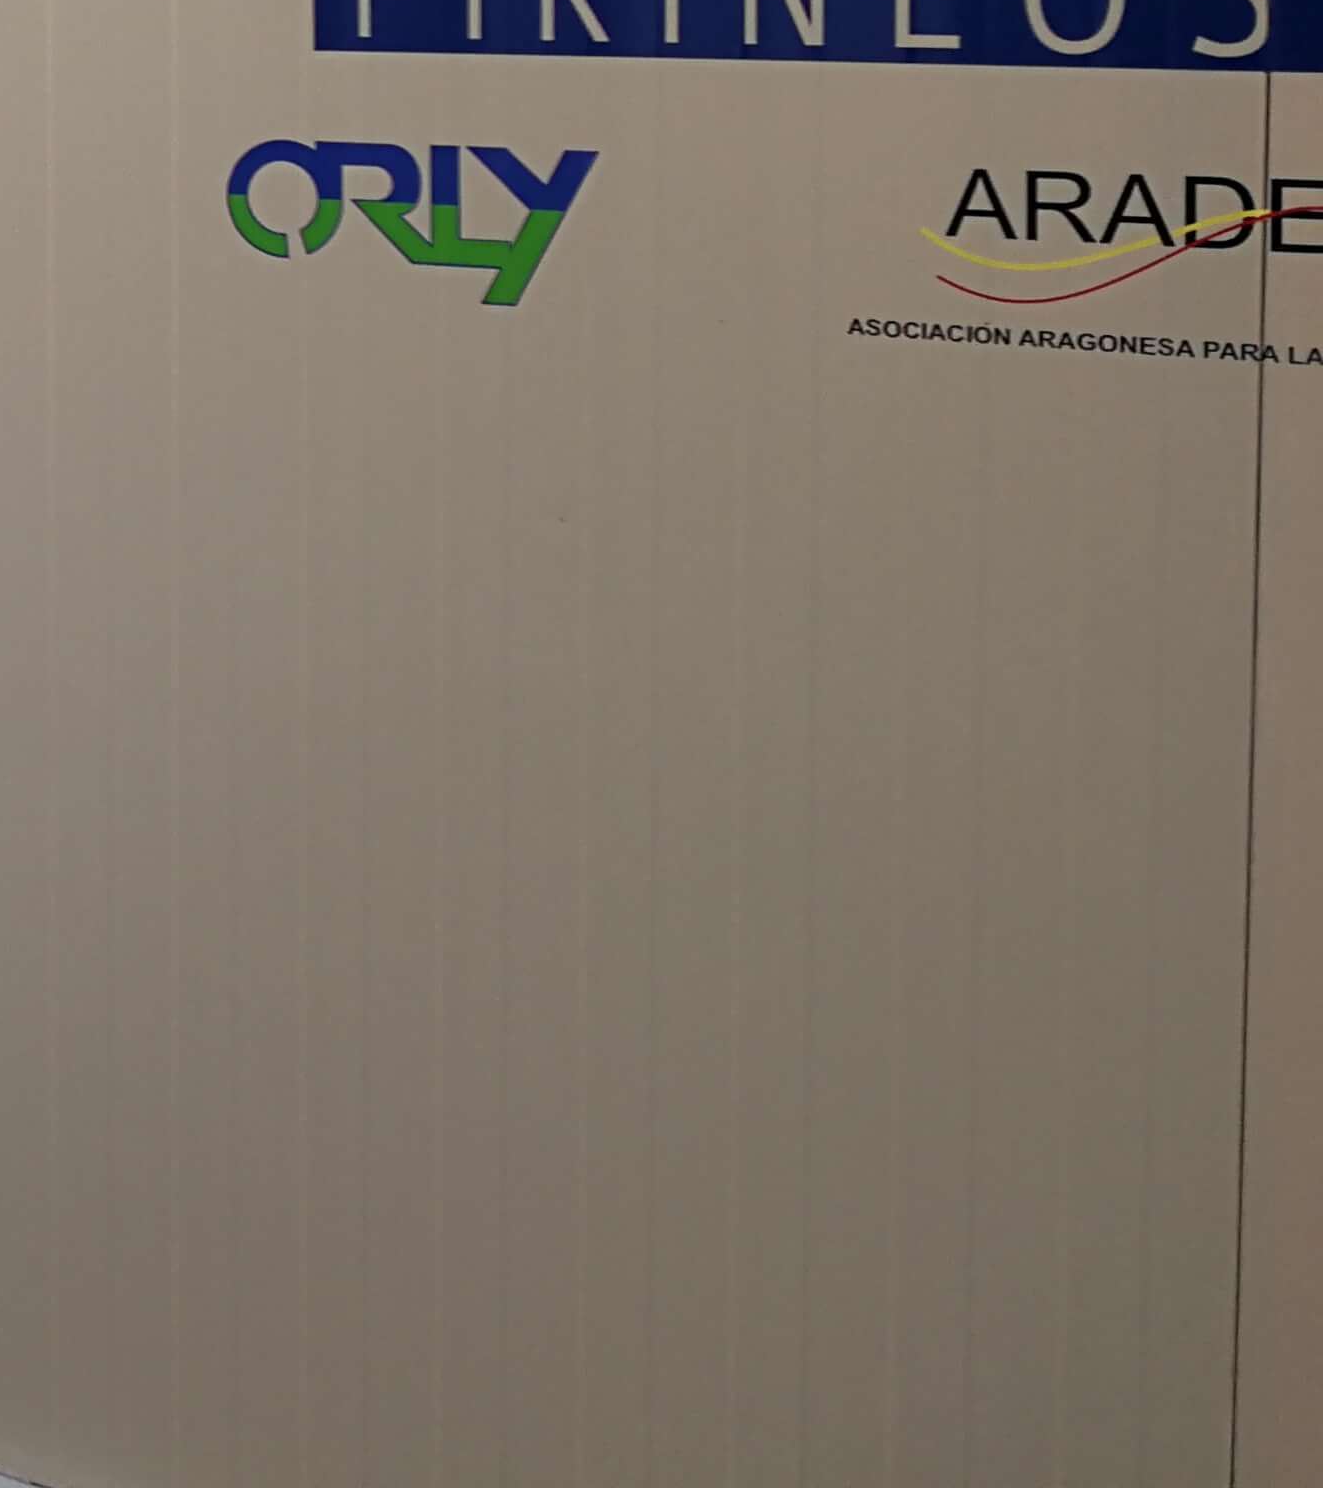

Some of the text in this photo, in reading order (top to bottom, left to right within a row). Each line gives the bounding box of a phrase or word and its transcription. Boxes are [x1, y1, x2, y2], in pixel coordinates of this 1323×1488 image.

[227, 139, 600, 307] ORLY
[946, 168, 1323, 255] ARADE
[847, 317, 1011, 346] ASOCIACIÓN
[1018, 329, 1196, 359] ARAGONESA
[1203, 340, 1279, 364] PARA
